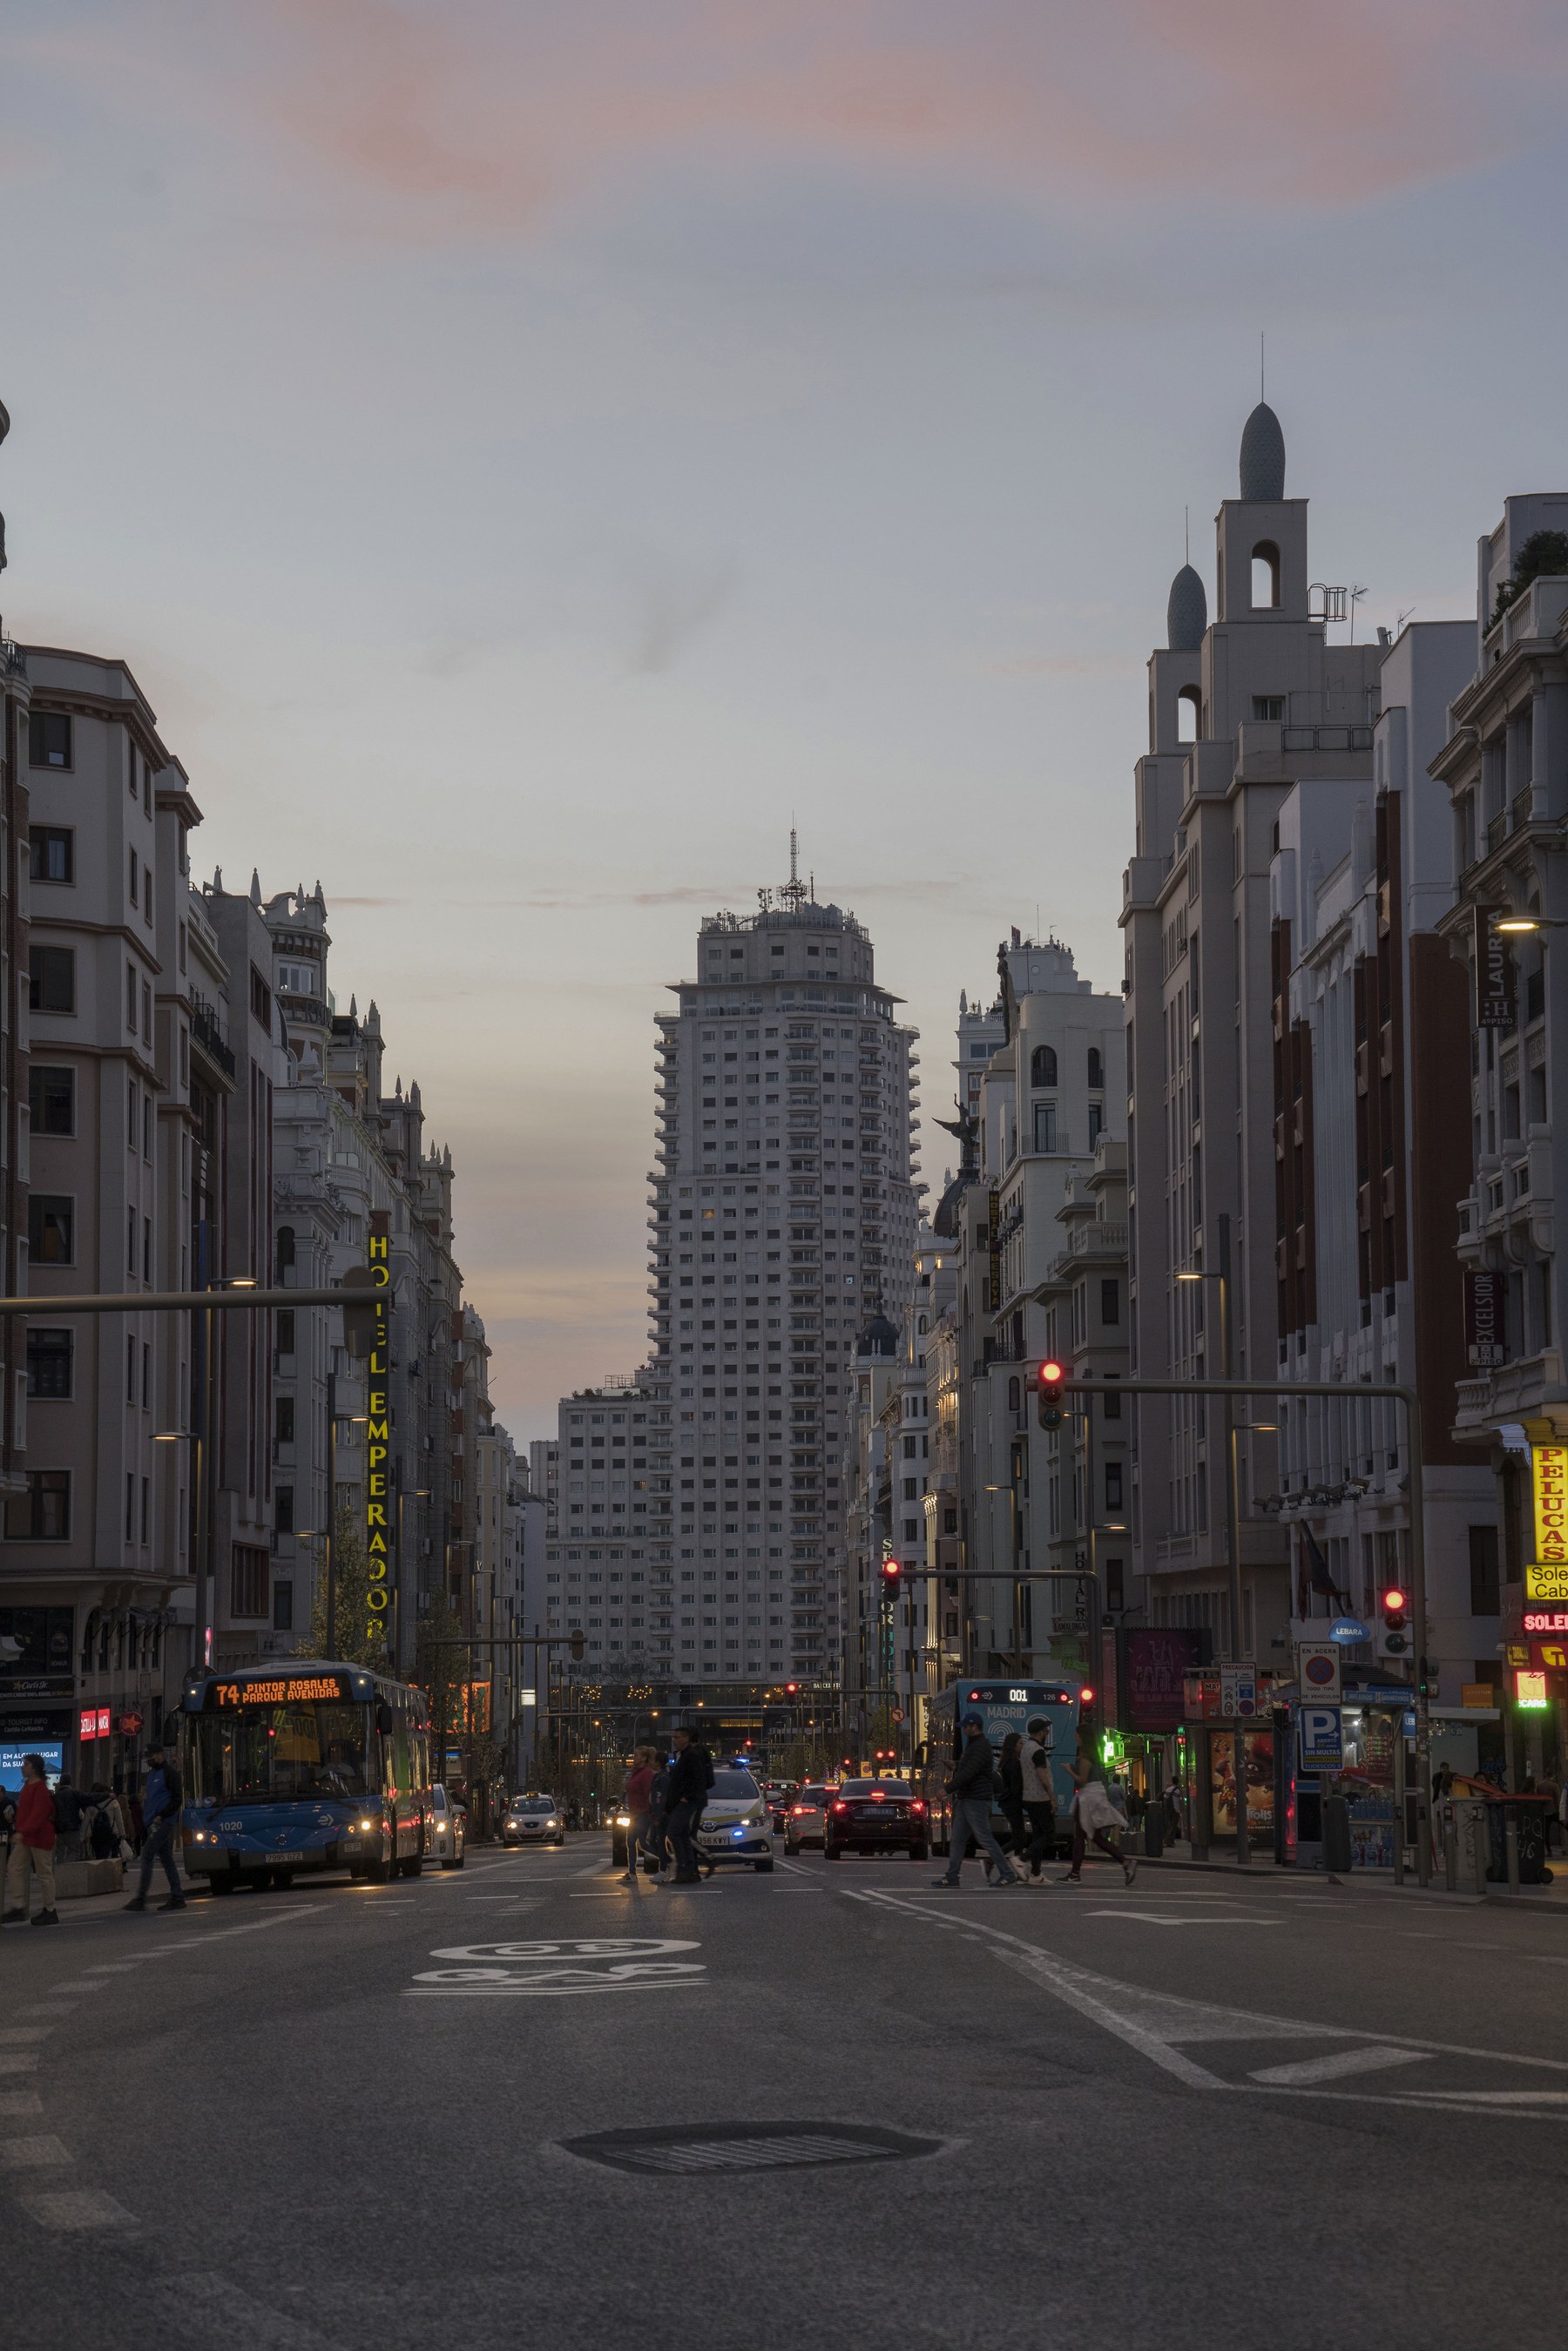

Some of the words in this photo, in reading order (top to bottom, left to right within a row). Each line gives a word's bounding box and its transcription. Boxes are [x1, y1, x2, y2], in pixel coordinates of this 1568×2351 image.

[989, 1194, 998, 1238] HOSTAL
[990, 1253, 1000, 1306] BESAYA
[1475, 1274, 1495, 1344] EXCELSIOR
[1538, 1449, 1567, 1560] PELUCAS
[367, 1392, 389, 1640] EMPERADOR
[1075, 1551, 1085, 1604] HOTAL
[1054, 1622, 1085, 1632] LAMALONGA
[217, 1685, 240, 1706] 74
[242, 1691, 284, 1704] PARQUE
[287, 1686, 341, 1700] AVENIDAS
[247, 1681, 286, 1693] PINTOR
[289, 1678, 336, 1691] ROSALES
[1009, 1689, 1029, 1702] 001
[987, 1706, 1026, 1719] MADRID
[1305, 1710, 1337, 1748] P
[219, 1821, 243, 1832] 1020
[267, 1854, 287, 1862] 7995
